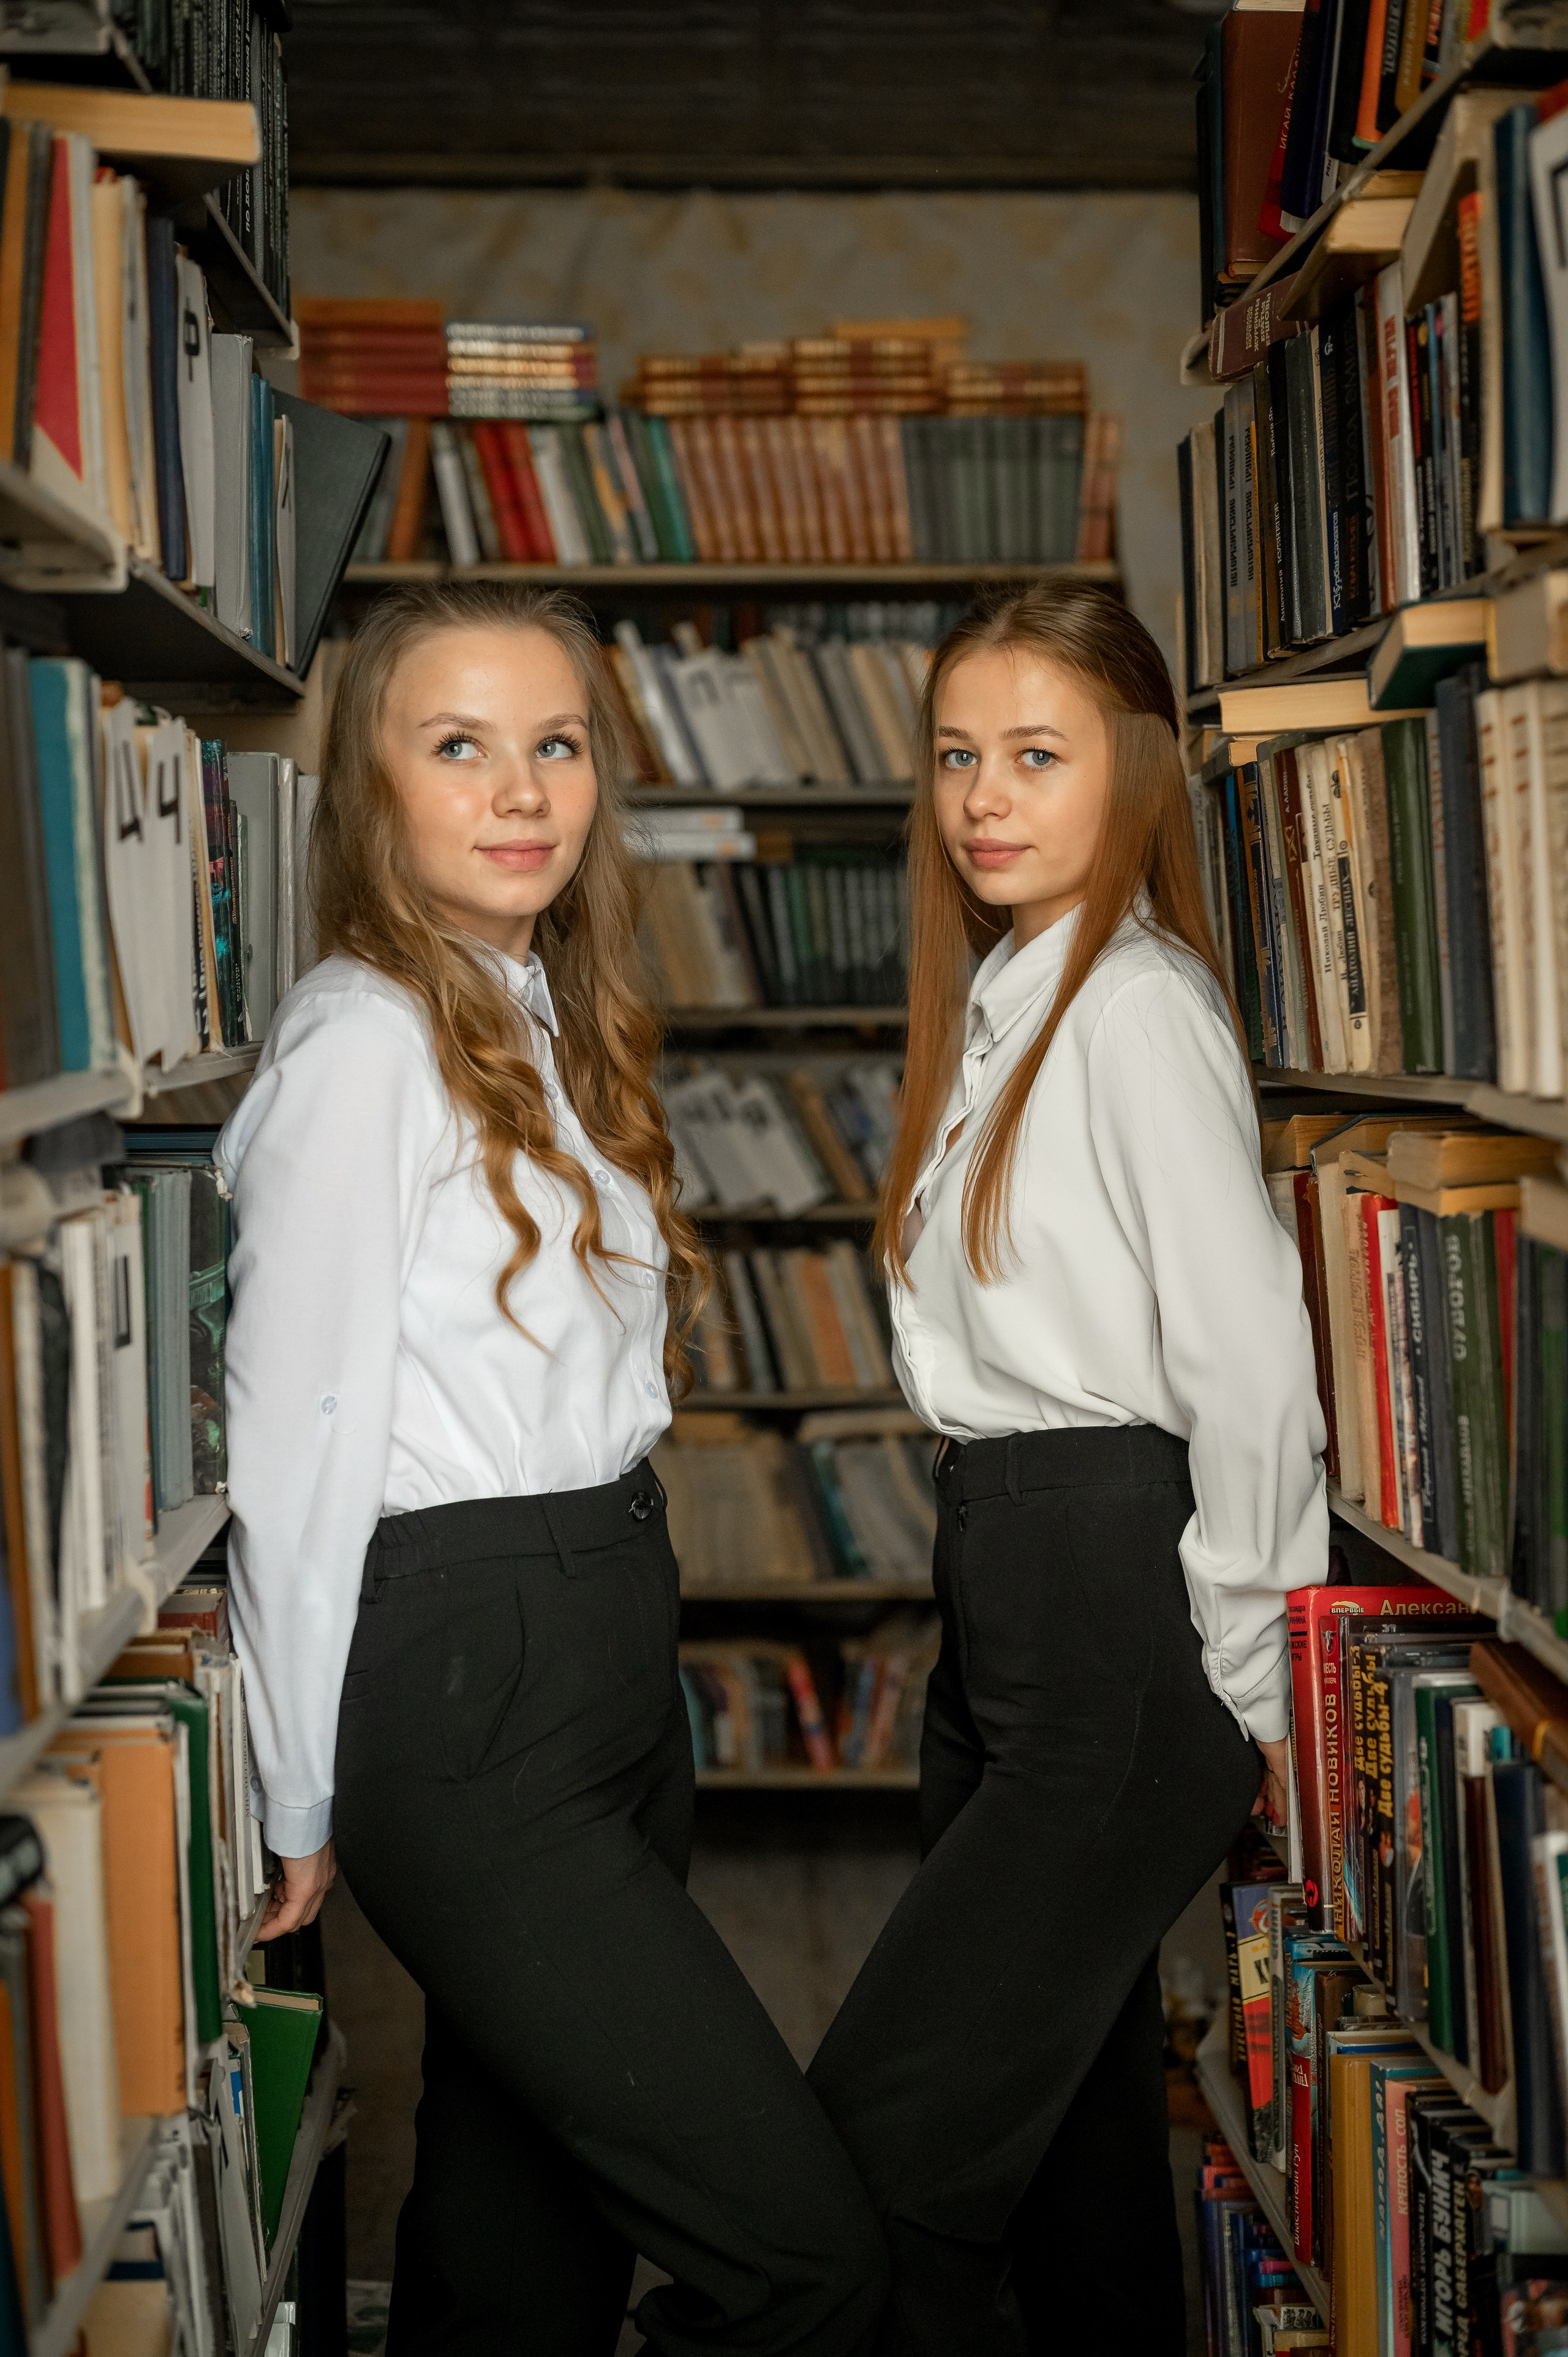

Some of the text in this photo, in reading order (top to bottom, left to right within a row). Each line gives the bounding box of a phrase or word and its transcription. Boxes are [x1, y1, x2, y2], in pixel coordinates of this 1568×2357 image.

[1279, 107, 1291, 149] ИСАЙ
[1343, 313, 1359, 501] ПОСОЛ ЭМИРА
[1311, 814, 1321, 860] Трудные
[1322, 803, 1335, 851] СУДЬБЫ
[1318, 883, 1327, 921] Любин
[1327, 856, 1341, 911] ТРУДНЫЕ
[1342, 873, 1359, 995] АНАТОЛИЙ ЛЕСНЫХ
[1322, 926, 1332, 973] Николай
[1336, 930, 1346, 964] Любин
[1408, 1253, 1423, 1343] СИБИРЬ
[1445, 1234, 1468, 1361] СУВОРОВ
[1349, 1645, 1365, 1771] Две судьбы-3
[1362, 1655, 1378, 1779] Две судьбы
[1372, 1681, 1393, 1818] Две судьбы-4
[1325, 1693, 1342, 1923] НИКОЛАЙ НОВИКОВ
[1396, 2144, 1408, 2216] КРЕПОСТЬ
[1431, 2149, 1453, 2336] ИГОРЬ БУНИЧ
[1453, 2180, 1468, 2309] САБЕРХАГЕН
